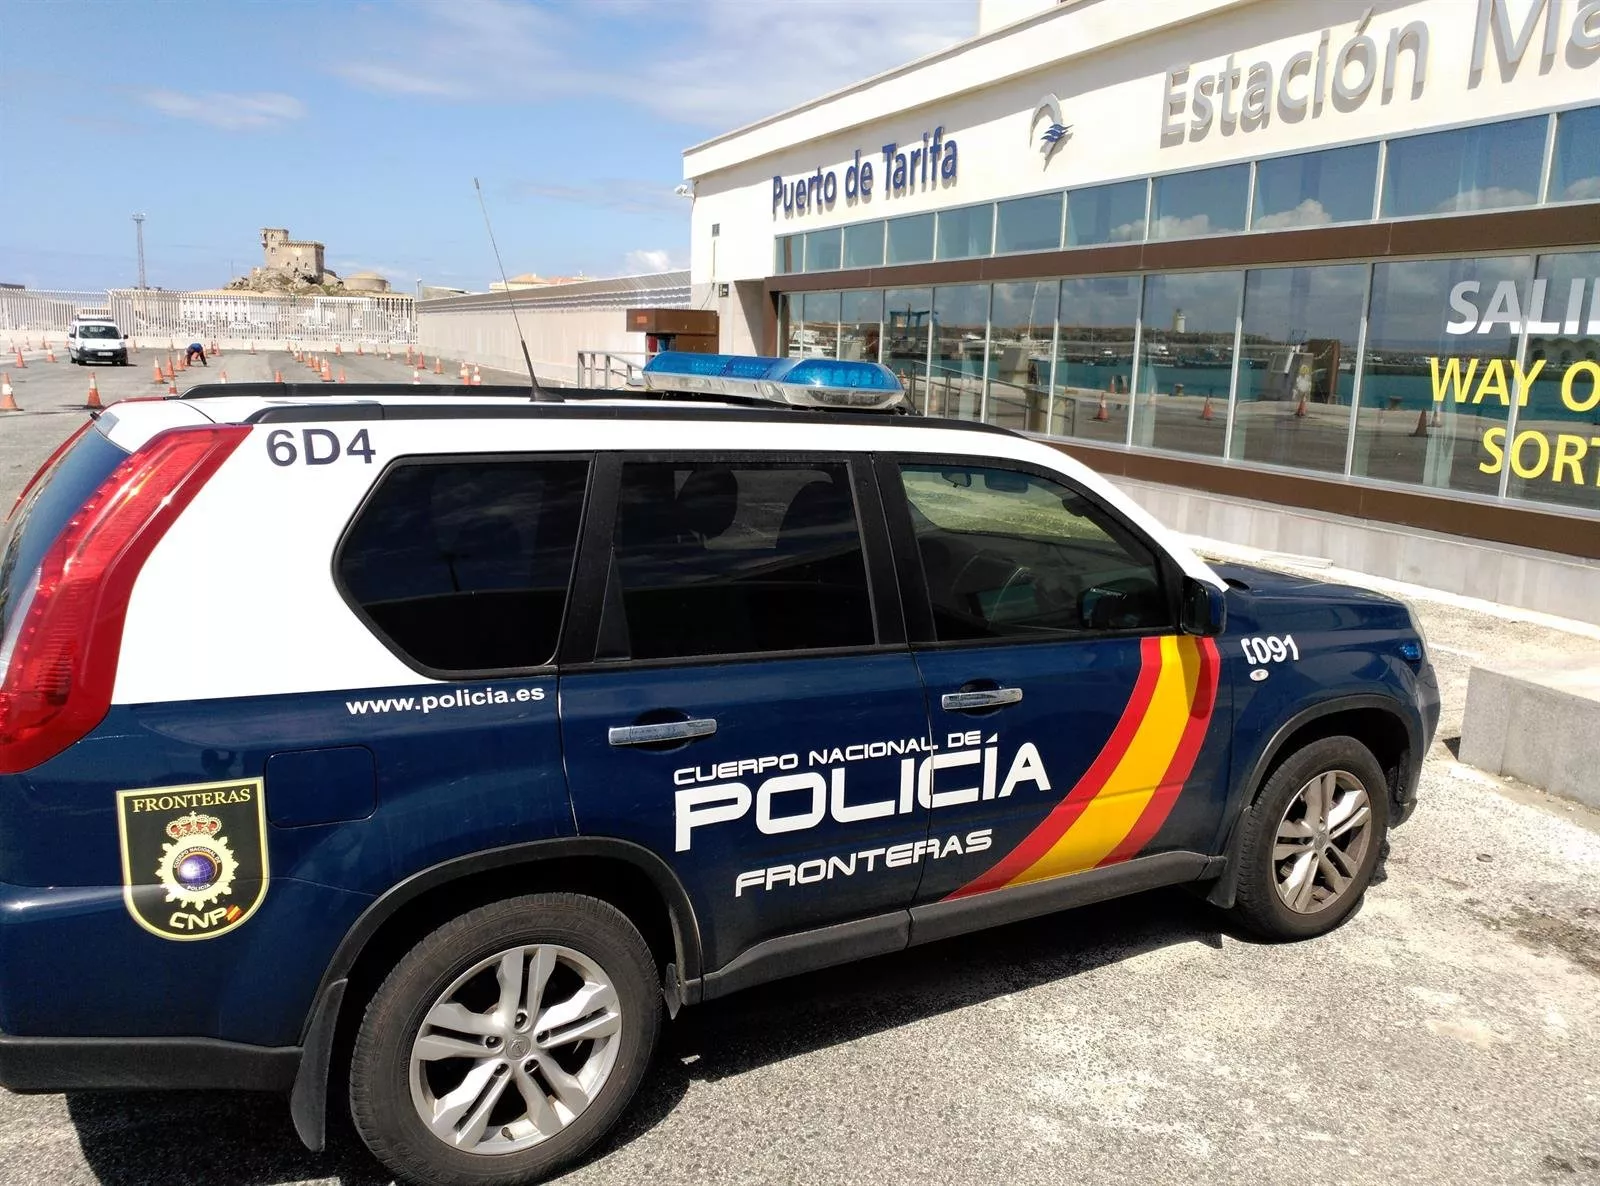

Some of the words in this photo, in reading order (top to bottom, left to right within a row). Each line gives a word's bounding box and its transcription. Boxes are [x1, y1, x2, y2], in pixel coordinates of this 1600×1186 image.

[1164, 6, 1429, 135] Estación
[772, 166, 837, 215] Puerto
[845, 149, 874, 199] de
[882, 126, 958, 191] Tarifa
[1446, 278, 1600, 335] SALI
[1430, 357, 1547, 407] WAY
[266, 428, 376, 467] 6D4
[1253, 634, 1299, 662] 091
[345, 687, 545, 715] www.policia.es
[673, 753, 799, 786] CUERPO
[808, 736, 939, 767] NACIONAL
[947, 730, 982, 749] DE
[132, 788, 251, 813] FRONTERAS
[674, 732, 1052, 852] POLICÍA
[734, 828, 993, 898] FRONTERAS
[169, 907, 227, 930] CNP
